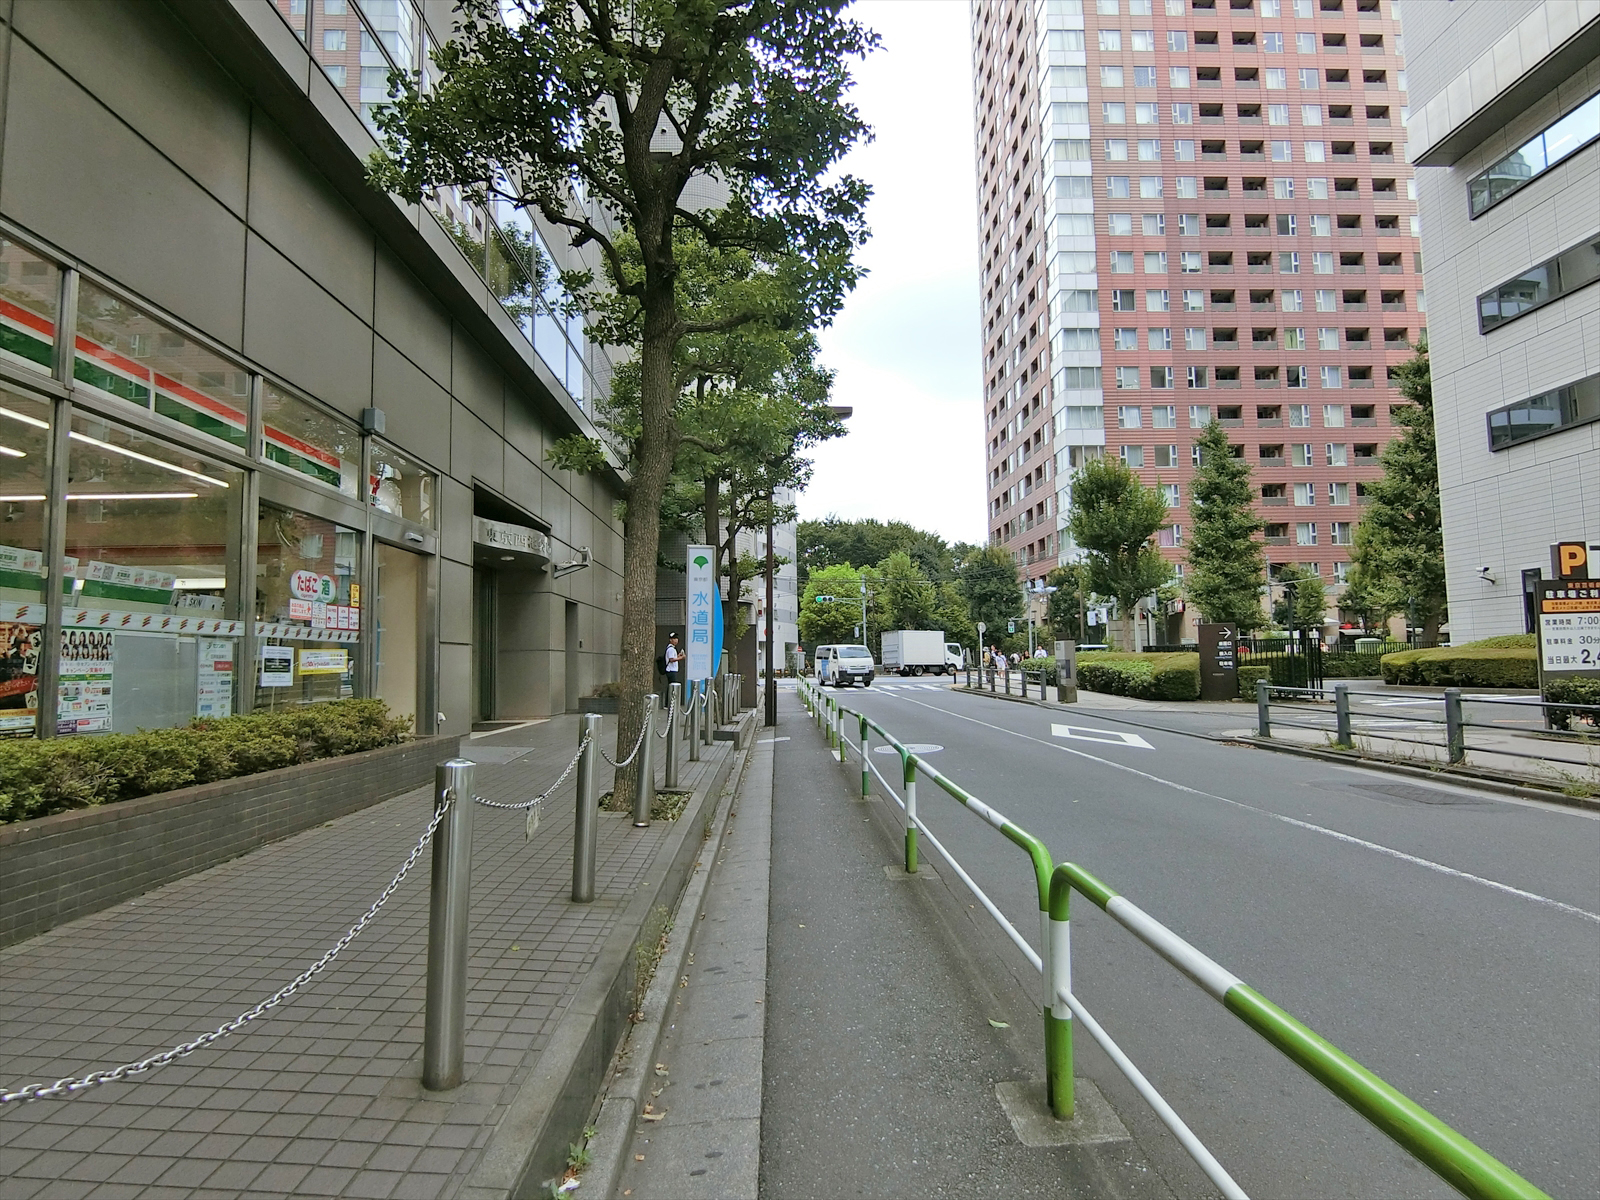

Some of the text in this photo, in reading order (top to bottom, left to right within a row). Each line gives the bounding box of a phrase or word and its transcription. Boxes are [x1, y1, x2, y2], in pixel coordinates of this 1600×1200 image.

[1560, 545, 1586, 575] P
[297, 574, 318, 593] たばこ
[321, 579, 331, 596] 酒
[692, 591, 709, 645] 水道局
[1577, 616, 1599, 625] 7:00
[1547, 655, 1578, 665] 当日最大
